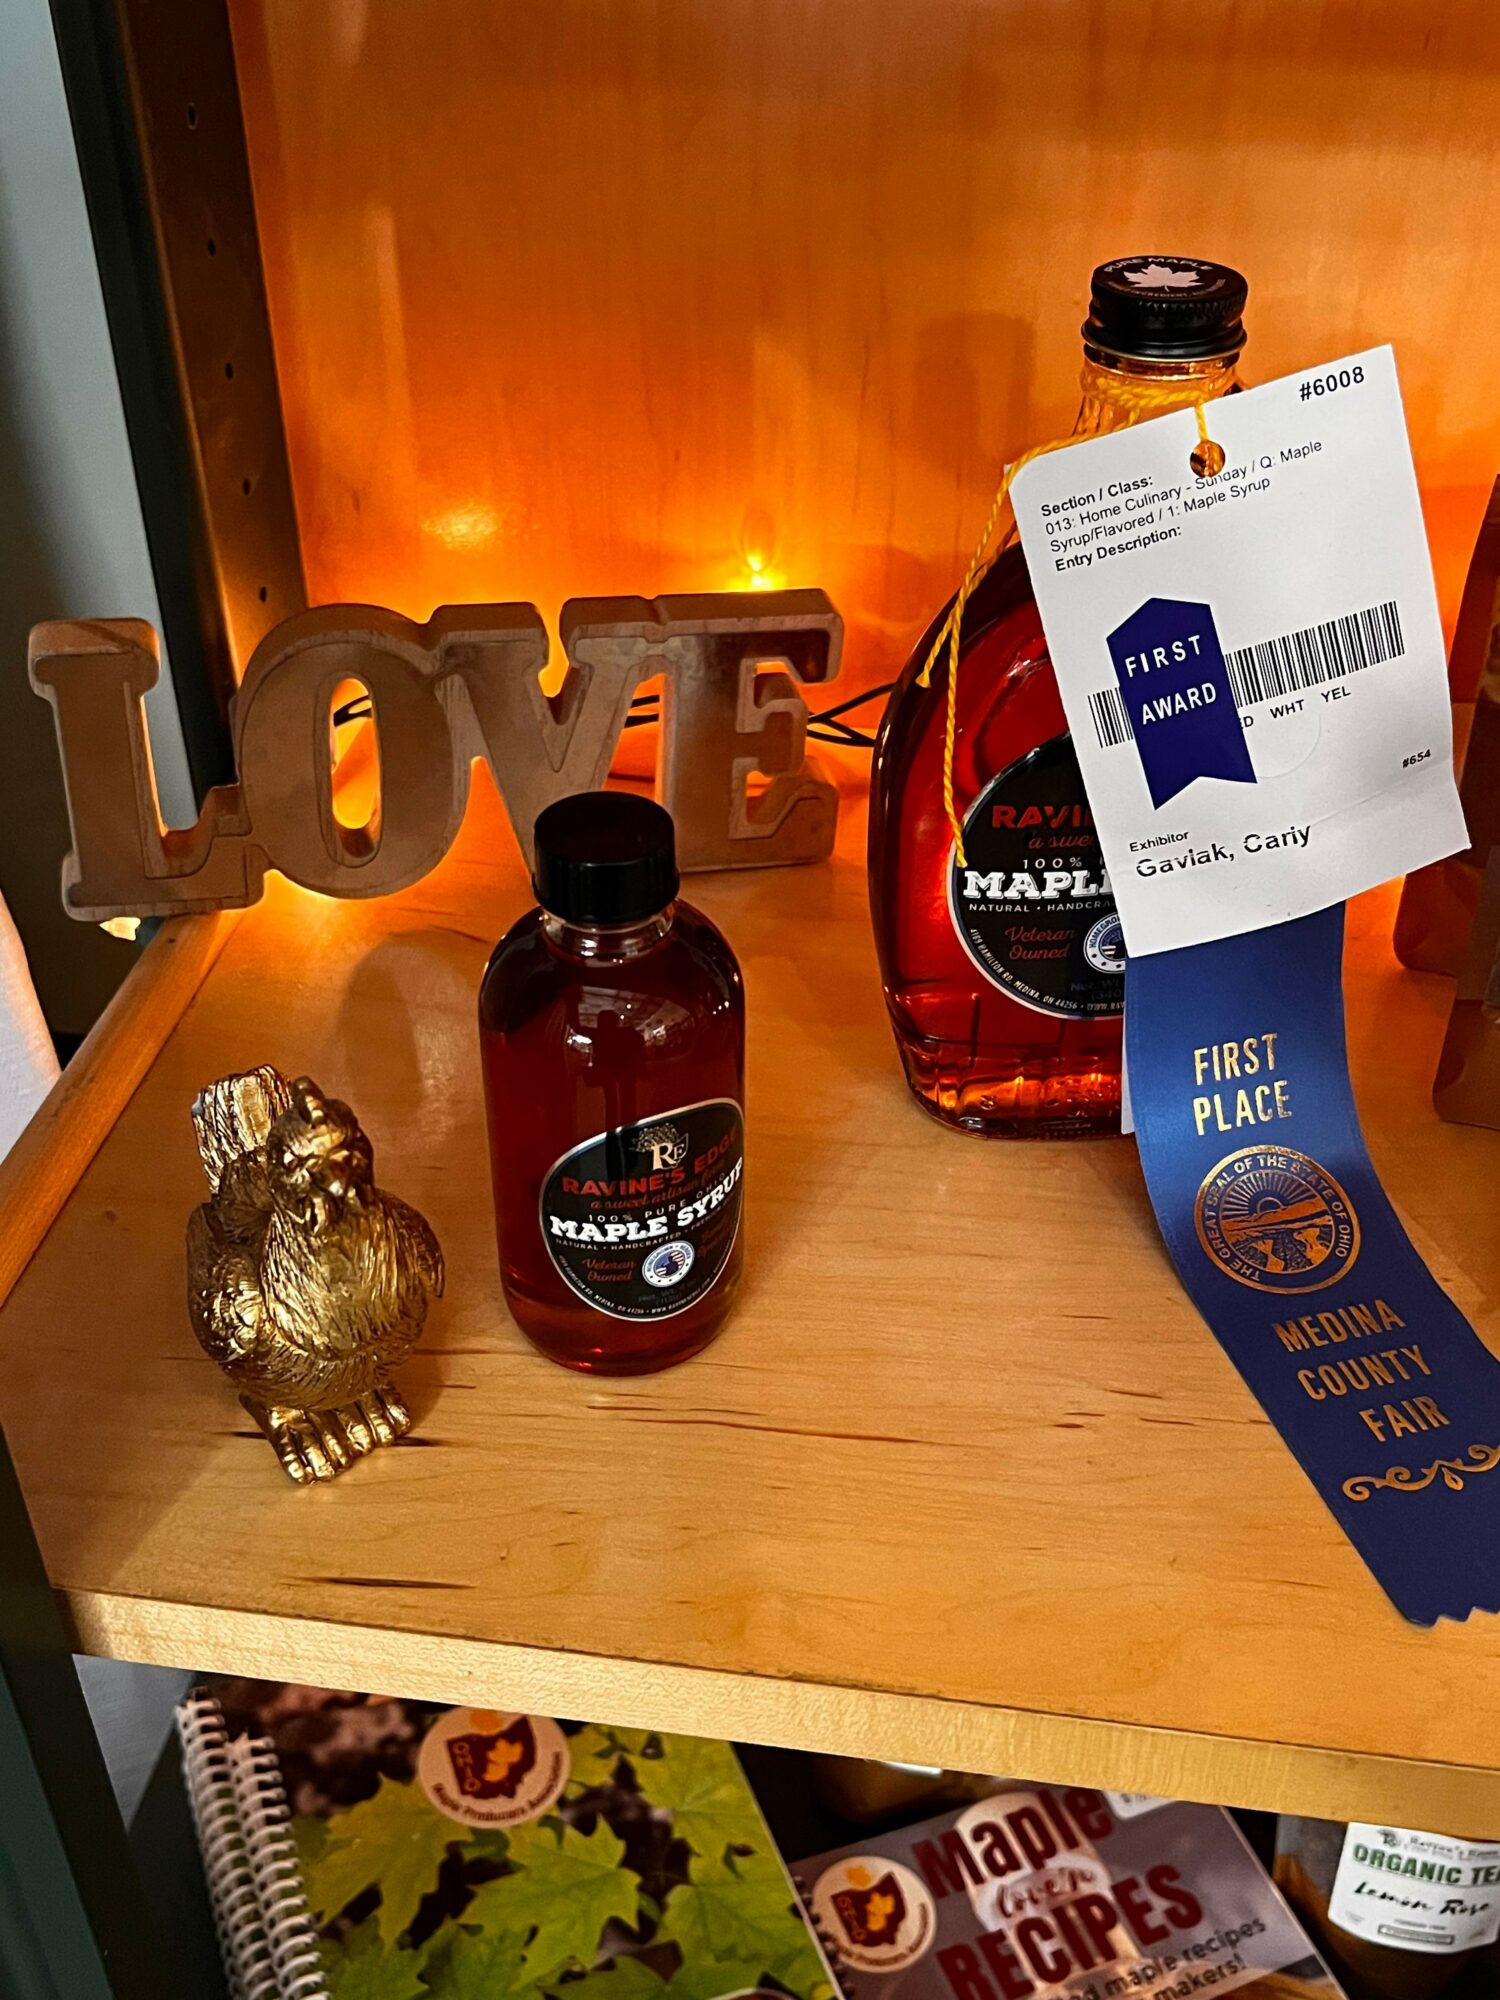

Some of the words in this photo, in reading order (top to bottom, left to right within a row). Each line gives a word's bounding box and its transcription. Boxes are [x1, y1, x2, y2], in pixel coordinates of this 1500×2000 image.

[1104, 259, 1144, 272] PURE
[1148, 257, 1214, 270] MAPLE
[1299, 366, 1365, 401] #6008
[1041, 494, 1096, 517] Section
[1107, 476, 1154, 498] Class:
[1045, 517, 1076, 535] 013:
[1079, 504, 1121, 525] Home
[1125, 486, 1182, 511] Culinary
[1195, 466, 1247, 490] Sunday
[1280, 441, 1323, 463] Maple
[1050, 511, 1155, 553] Syrup/Flavored
[1184, 491, 1227, 513] Maple
[1230, 477, 1271, 499] Syrup
[1055, 553, 1093, 571] Entry
[1096, 526, 1182, 559] Description:
[1124, 634, 1200, 678] FIRST
[1142, 682, 1217, 725] AWARD
[1269, 699, 1305, 719] WHT
[1320, 686, 1352, 703] YEL
[28, 587, 843, 922] LOVE
[1402, 748, 1432, 769] #654
[1129, 831, 1189, 852] Exhibitor
[1022, 856, 1082, 870] 100%
[969, 903, 1031, 913] NATURAL
[1003, 925, 1076, 942] Veteran
[1008, 943, 1072, 960] Owned
[1194, 1032, 1279, 1086] FIRST
[1193, 1080, 1293, 1136] PLACE
[1233, 1158, 1254, 1174] OF
[1256, 1154, 1288, 1169] THE
[549, 1215, 669, 1243] MAPLE
[677, 1156, 743, 1227] SYRUP
[562, 1166, 686, 1197] RAVINE'S
[1206, 1171, 1235, 1207] SEAL
[1290, 1162, 1336, 1200] STATE
[588, 1212, 633, 1223] 100%
[644, 1198, 687, 1219] PURE
[1331, 1201, 1348, 1220] OF
[555, 1237, 599, 1251] NATURAL
[610, 1231, 682, 1251] HANDCRAFTED
[1204, 1208, 1231, 1259] GREAT
[1335, 1224, 1350, 1258] OHIO
[581, 1257, 636, 1270] Veteran
[1230, 1258, 1261, 1281] THE
[1271, 1299, 1406, 1352] MEDINA
[1296, 1344, 1432, 1401] COUNTY
[1359, 1394, 1450, 1443] FAIR
[912, 1786, 1114, 1899] Maple
[1353, 1842, 1463, 1885] ORGANIC
[1354, 1880, 1434, 1911] Lemon
[1438, 1898, 1491, 1917] Rose
[936, 1864, 1204, 2000] RECIPES
[1104, 1953, 1177, 1997] maple
[1182, 1917, 1267, 1962] recipes
[1153, 1953, 1248, 2000] makers!
